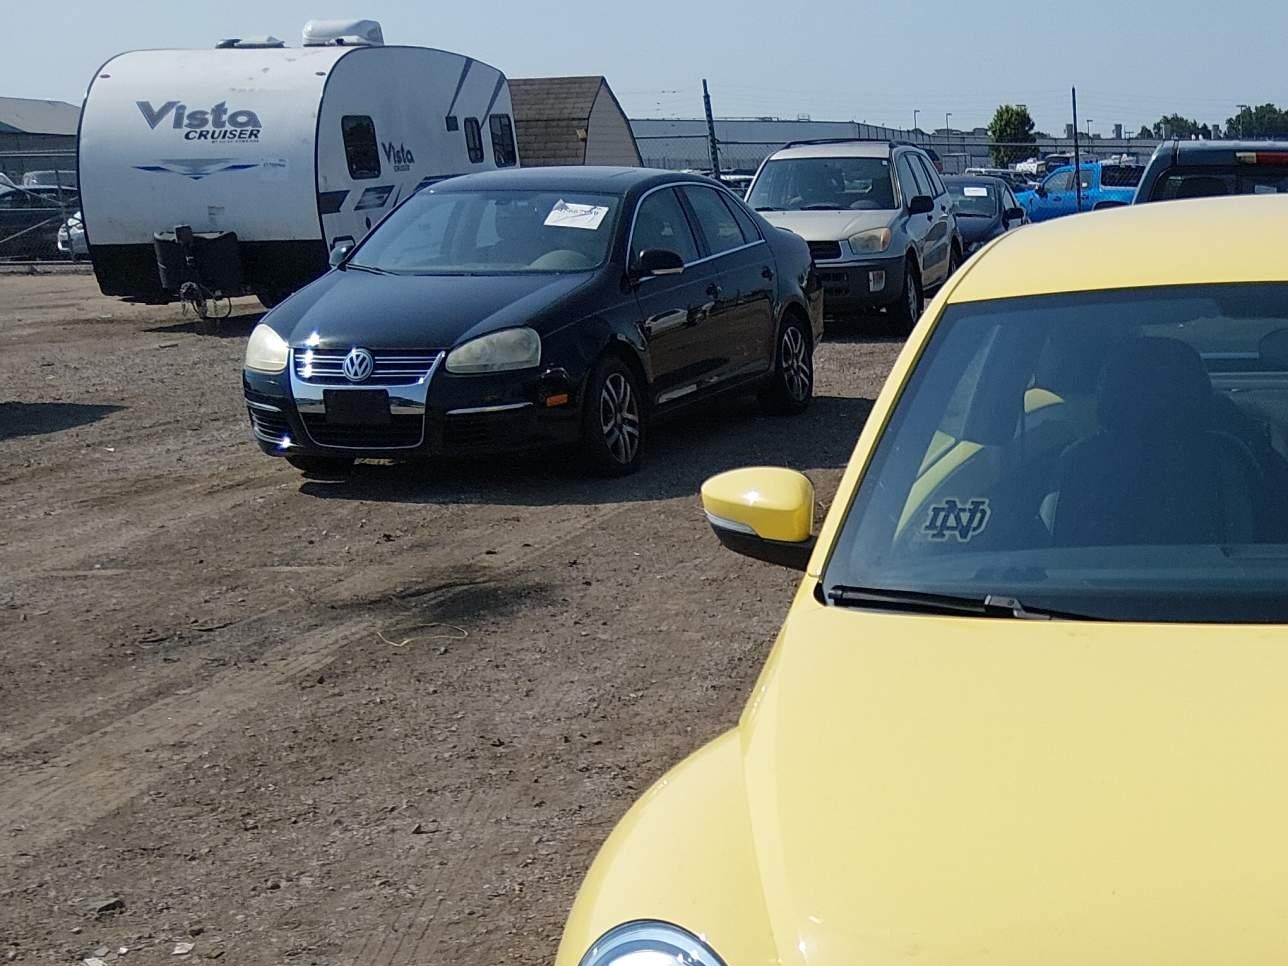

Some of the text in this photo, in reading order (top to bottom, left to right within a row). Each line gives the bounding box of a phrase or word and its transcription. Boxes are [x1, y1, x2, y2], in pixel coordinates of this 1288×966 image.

[136, 101, 262, 130] Vista
[184, 129, 261, 141] CRUISER
[381, 141, 415, 165] Vista
